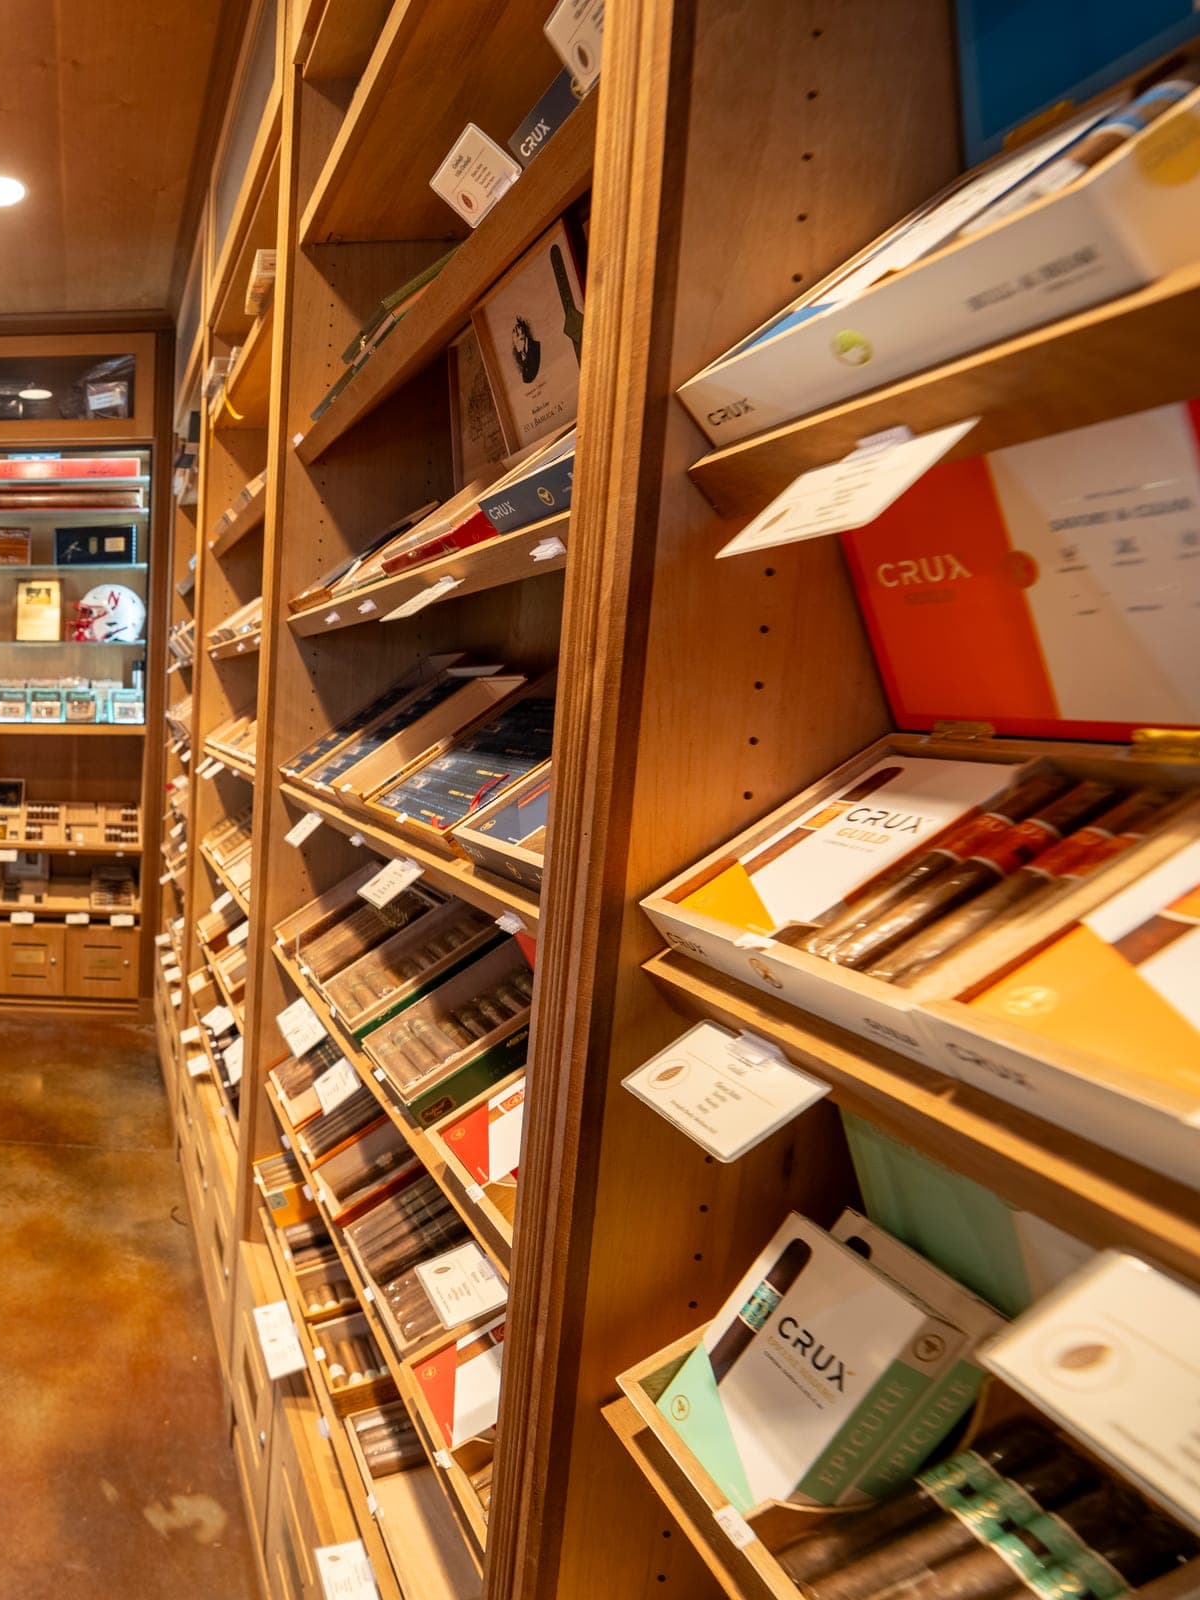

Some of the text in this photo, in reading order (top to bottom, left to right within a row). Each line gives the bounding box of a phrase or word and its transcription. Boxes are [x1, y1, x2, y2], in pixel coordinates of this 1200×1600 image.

[520, 118, 550, 158] CRUX
[708, 397, 755, 426] CRUX
[488, 501, 517, 520] CRUX
[877, 554, 973, 588] CRUX
[836, 827, 890, 845] GUILD
[846, 807, 924, 834] CRUX
[778, 1316, 856, 1393] CRUX
[817, 1380, 913, 1489] EPICURE
[878, 1379, 974, 1482] EPICURE
